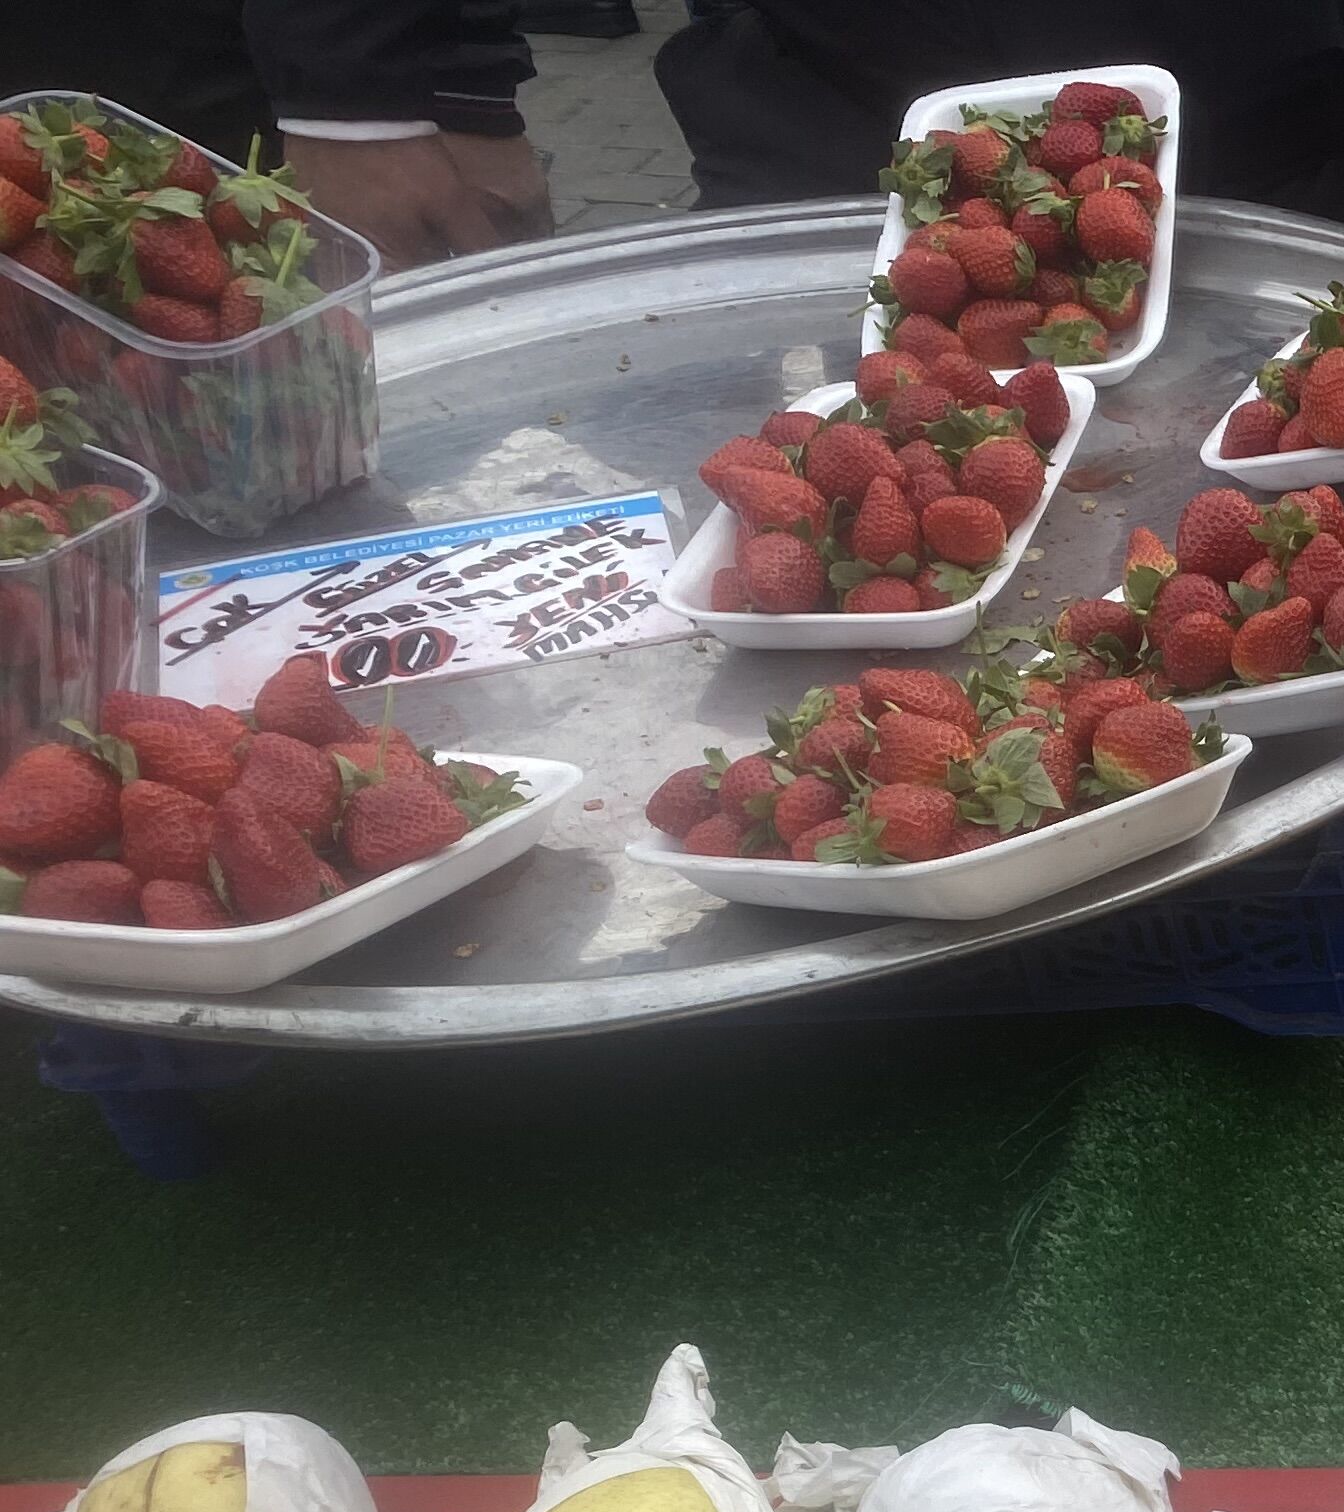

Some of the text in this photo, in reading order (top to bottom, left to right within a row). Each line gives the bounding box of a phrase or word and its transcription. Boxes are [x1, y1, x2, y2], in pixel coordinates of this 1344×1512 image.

[304, 537, 423, 564] BELEDİYESİ
[428, 526, 494, 544] PAZAR
[496, 518, 545, 533] YERİ
